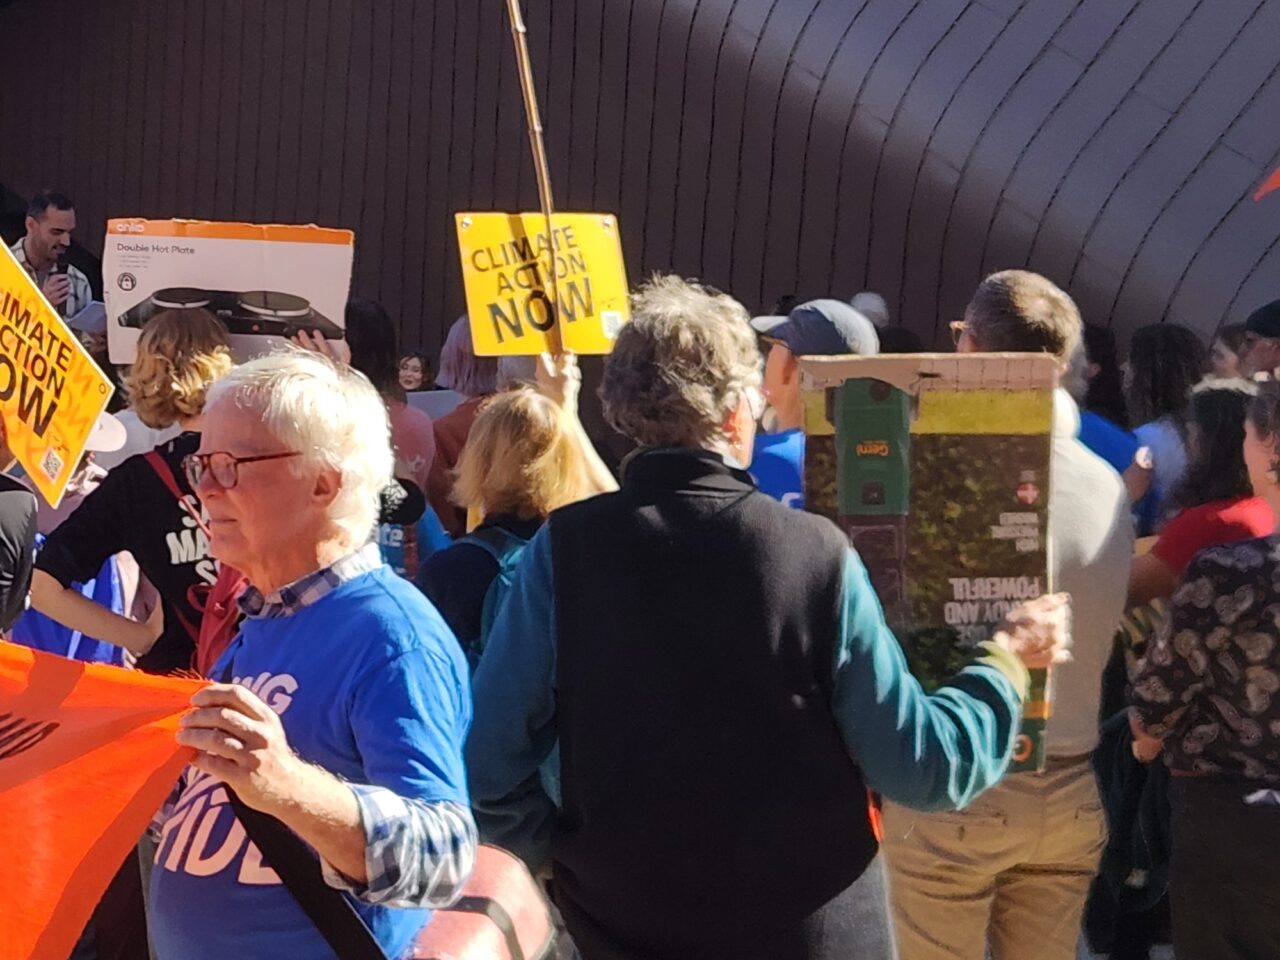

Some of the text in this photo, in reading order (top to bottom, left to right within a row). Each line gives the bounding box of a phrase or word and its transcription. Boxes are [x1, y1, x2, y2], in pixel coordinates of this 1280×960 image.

[117, 243, 195, 255] Double Hot Plate
[471, 225, 578, 273] CLIMATE
[497, 249, 587, 297] ACTION
[486, 277, 594, 344] NOW
[948, 577, 1040, 601] POWERFUL
[944, 601, 980, 625] AND
